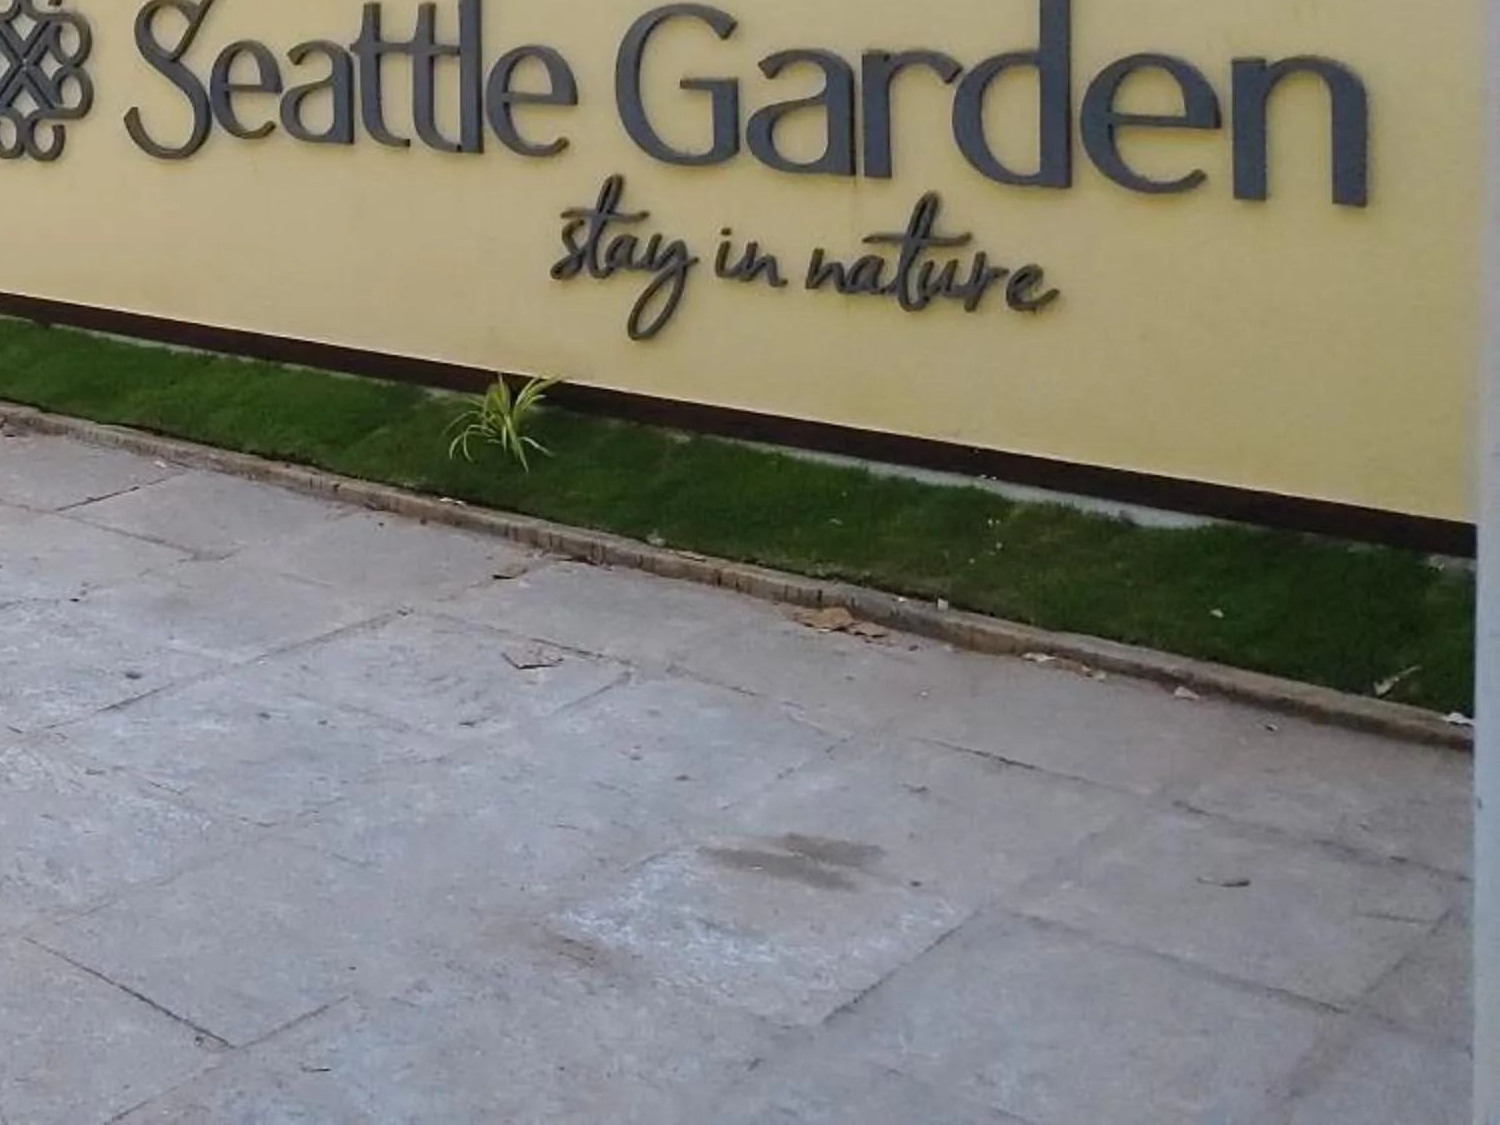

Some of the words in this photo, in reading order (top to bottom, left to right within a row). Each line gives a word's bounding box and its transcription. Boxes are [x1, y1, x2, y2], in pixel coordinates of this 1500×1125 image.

[550, 174, 698, 341] stay
[714, 227, 788, 288] in
[805, 190, 1060, 313] nature
